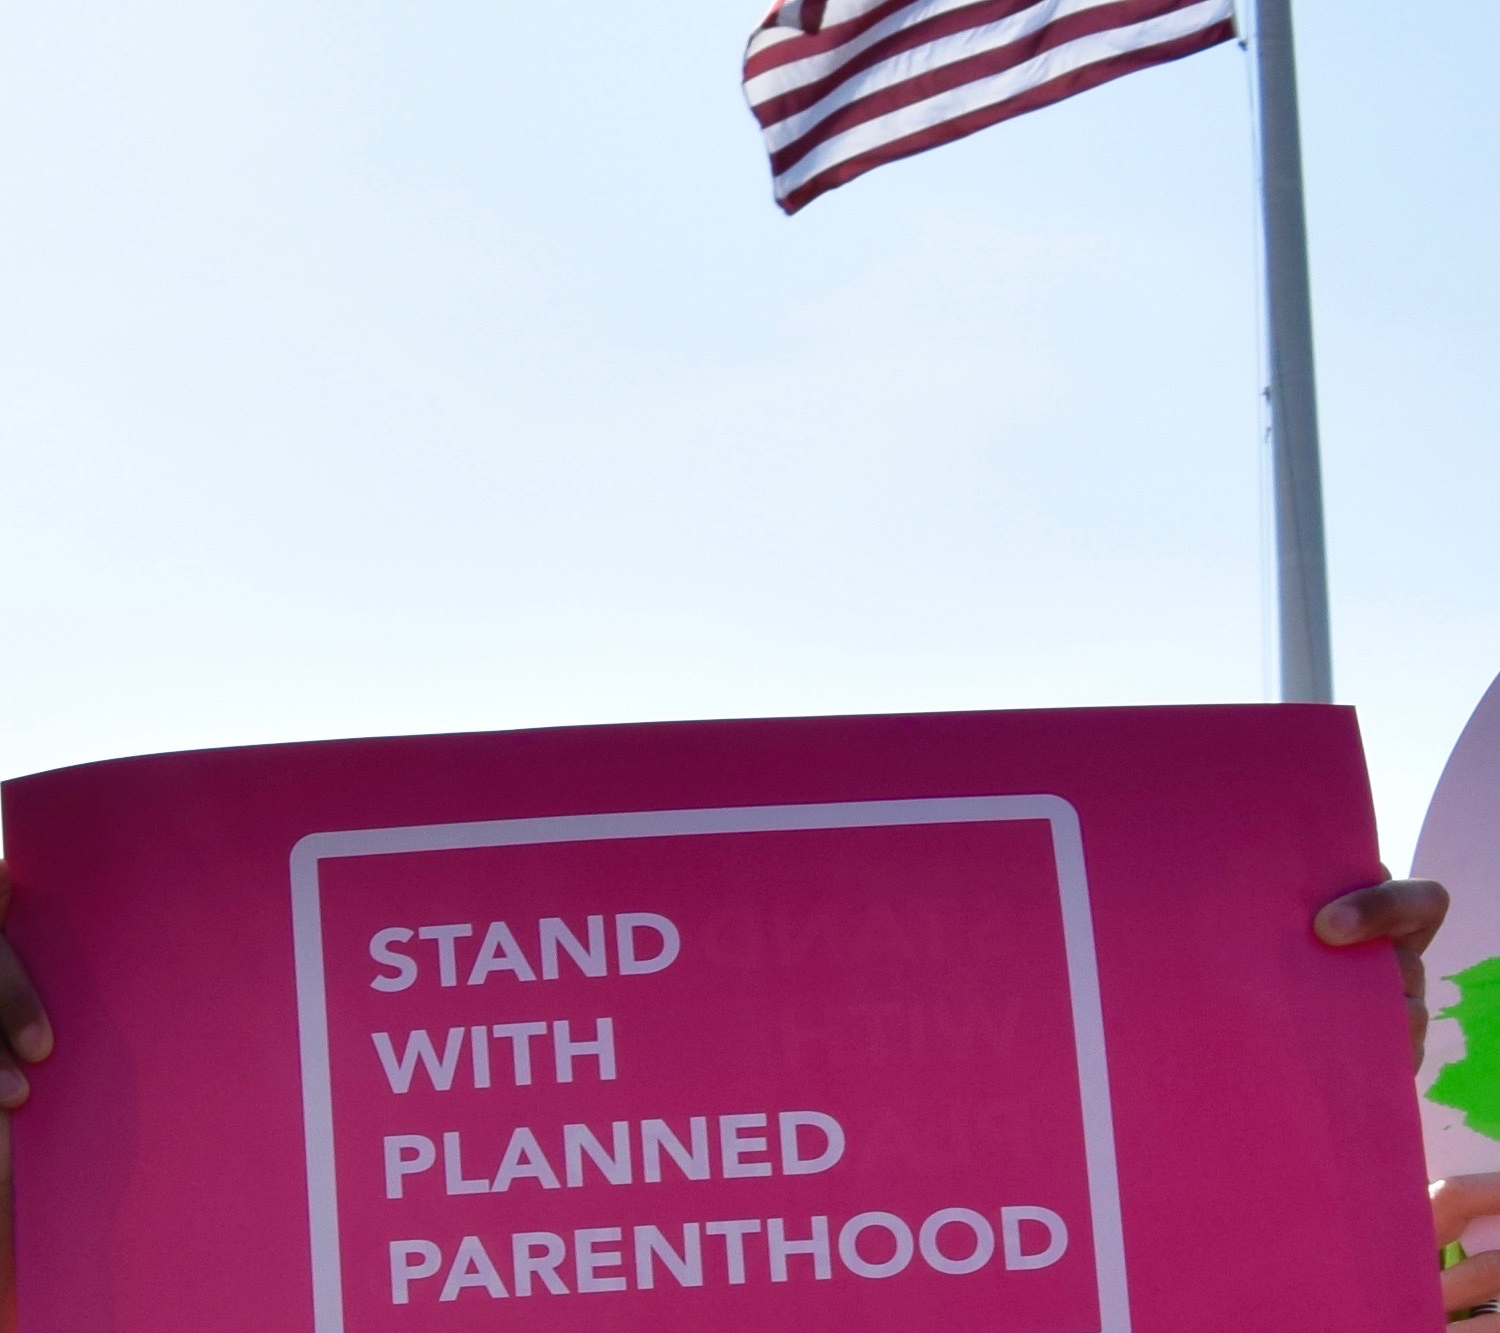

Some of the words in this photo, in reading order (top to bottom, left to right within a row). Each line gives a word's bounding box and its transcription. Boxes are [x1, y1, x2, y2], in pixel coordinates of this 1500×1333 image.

[368, 910, 682, 993] STAND
[371, 1016, 618, 1095] WITH
[383, 1108, 847, 1200] PLANNED
[388, 1204, 1070, 1306] PARENTHOOD
